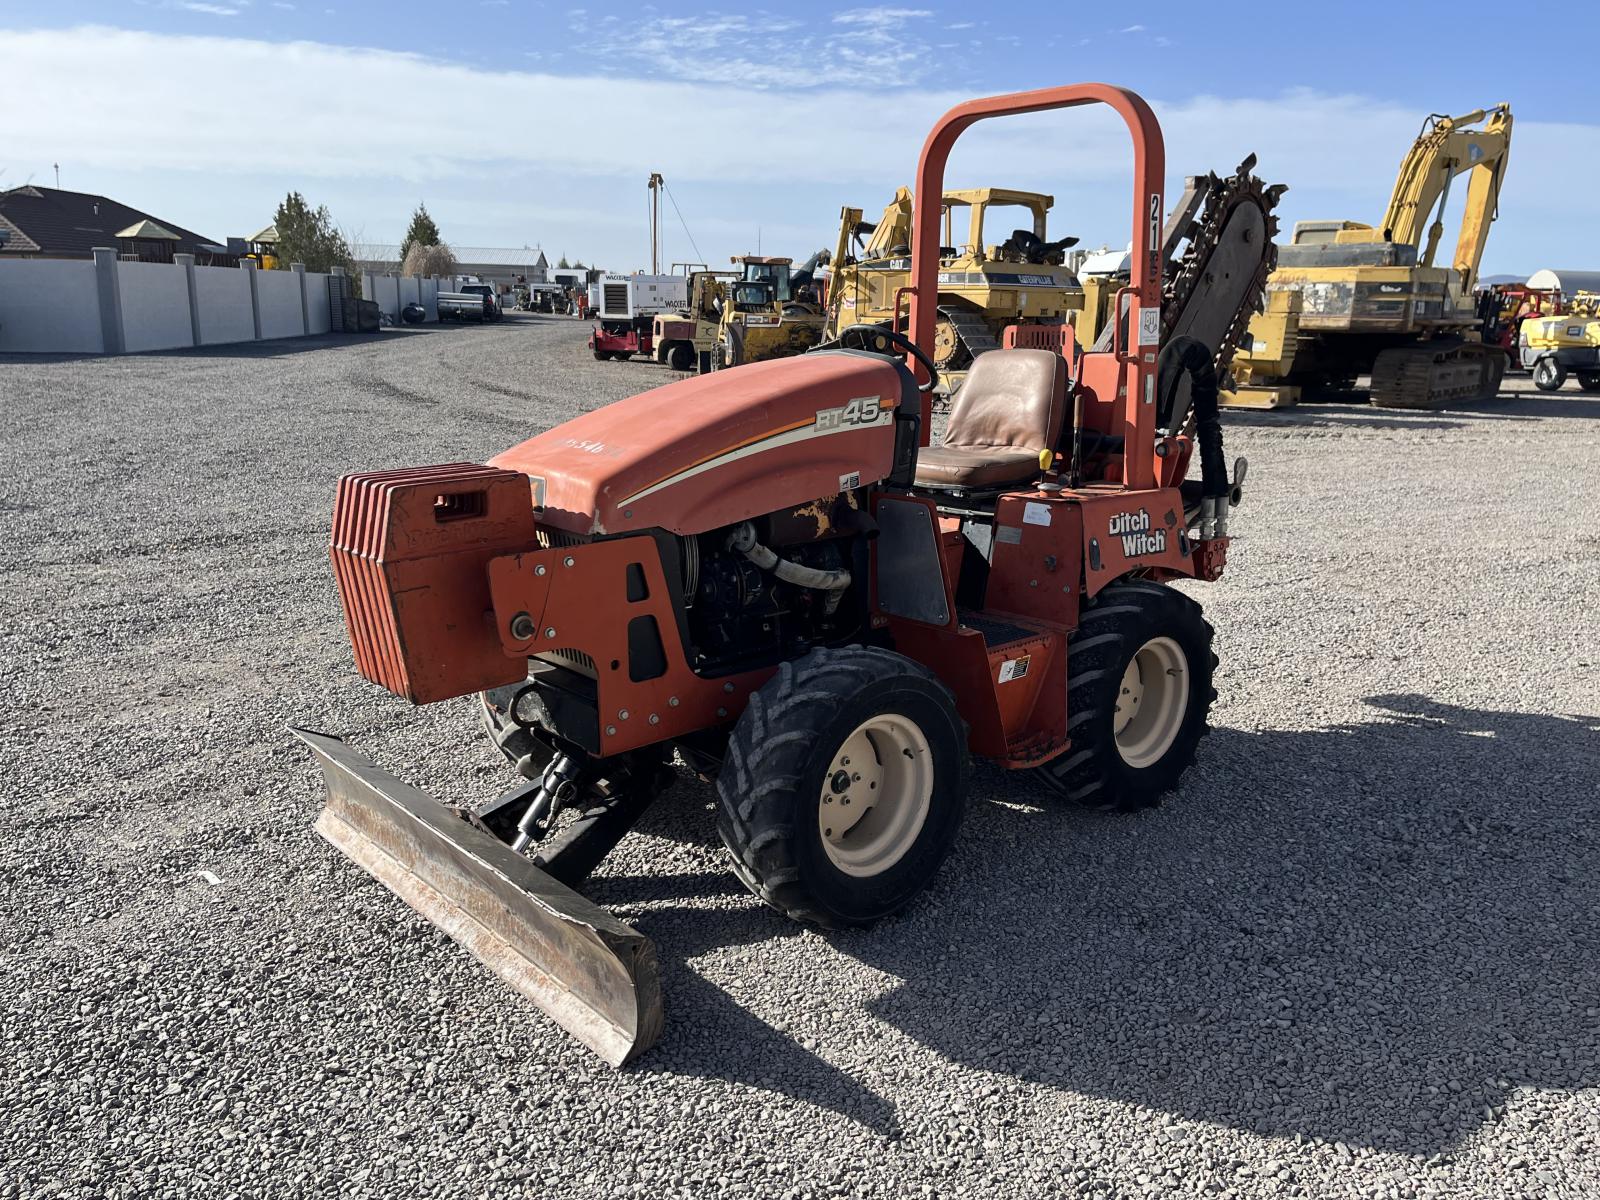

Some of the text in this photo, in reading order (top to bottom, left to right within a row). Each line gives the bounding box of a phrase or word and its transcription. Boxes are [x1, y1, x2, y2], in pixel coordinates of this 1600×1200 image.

[890, 260, 904, 269] CAT
[665, 301, 687, 309] WACKER
[815, 397, 880, 431] RT45
[1109, 509, 1149, 535] Ditch
[1122, 530, 1165, 557] Witch
